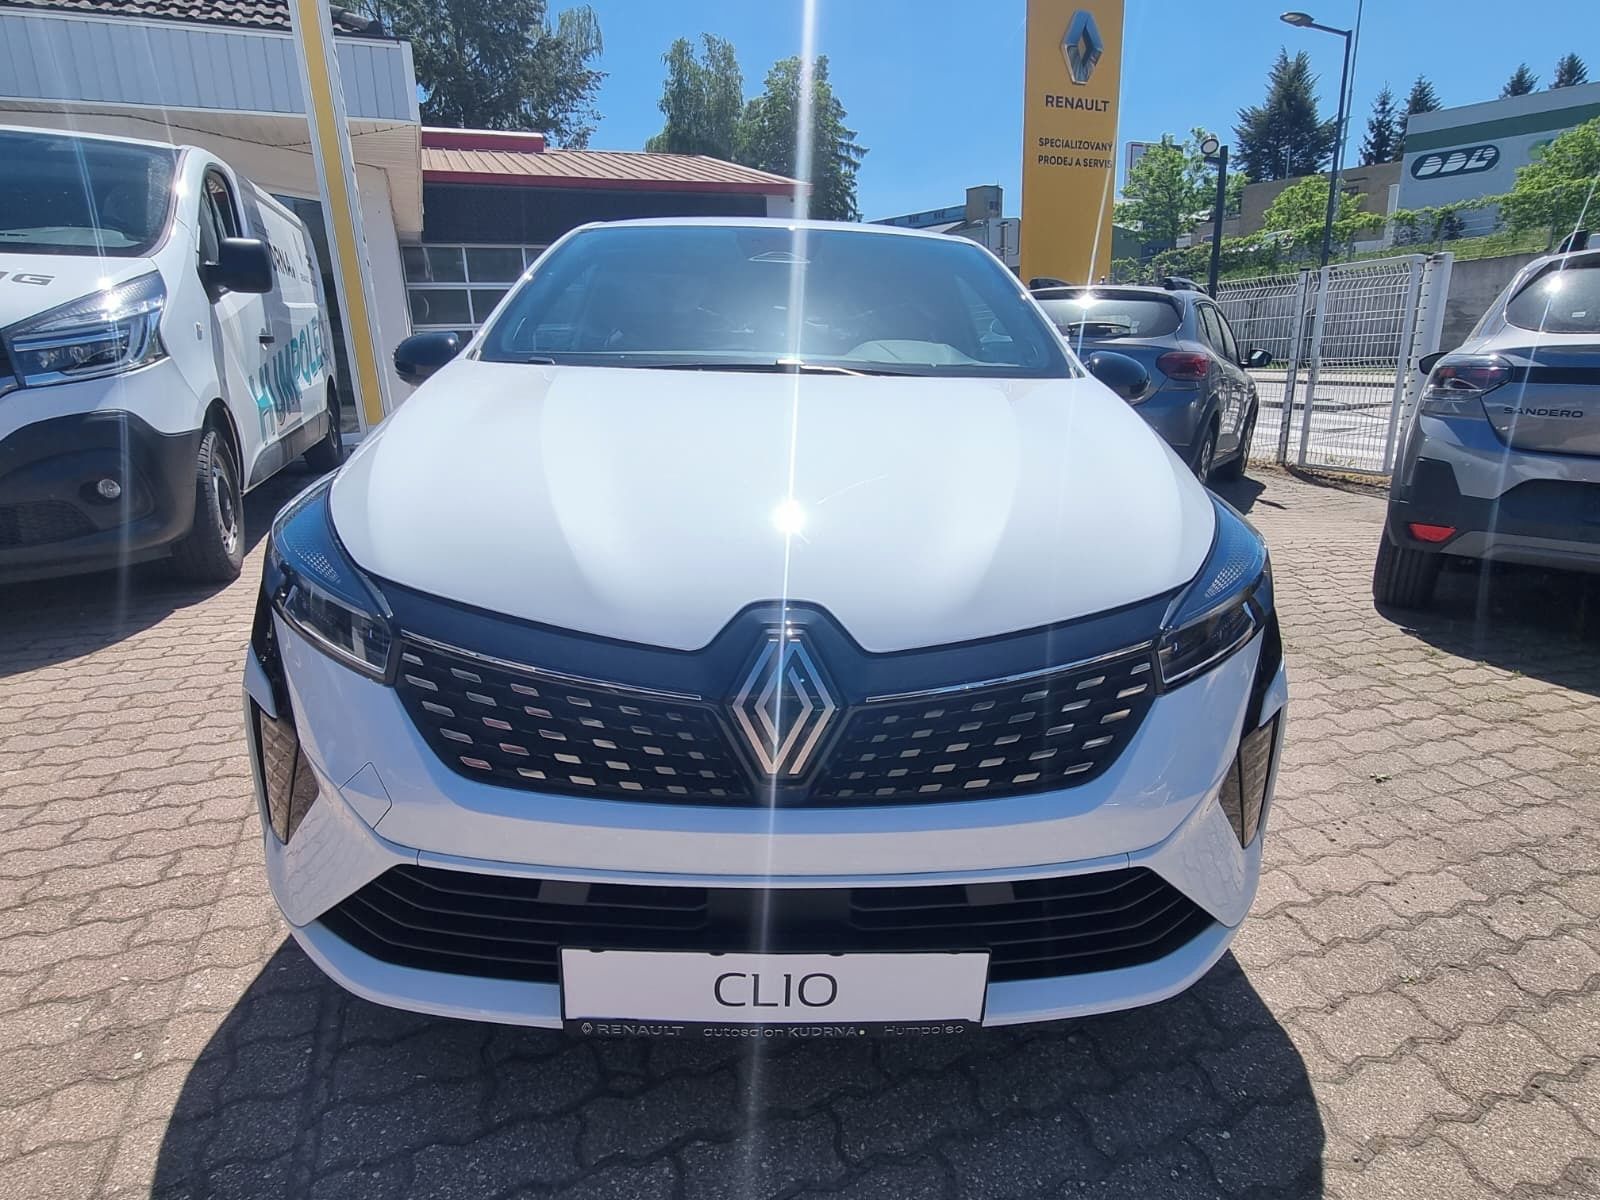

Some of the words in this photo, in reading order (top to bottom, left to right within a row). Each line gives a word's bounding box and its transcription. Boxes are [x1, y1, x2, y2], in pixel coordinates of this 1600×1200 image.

[1045, 94, 1110, 112] RENAULT
[1038, 154, 1073, 167] PRODEJ
[1074, 158, 1082, 168] A
[1083, 158, 1113, 169] SERVIS
[1503, 406, 1584, 419] SANDERO
[714, 972, 838, 1008] CLIO
[597, 1024, 685, 1036] RENAULT
[703, 1026, 784, 1038] autosalon
